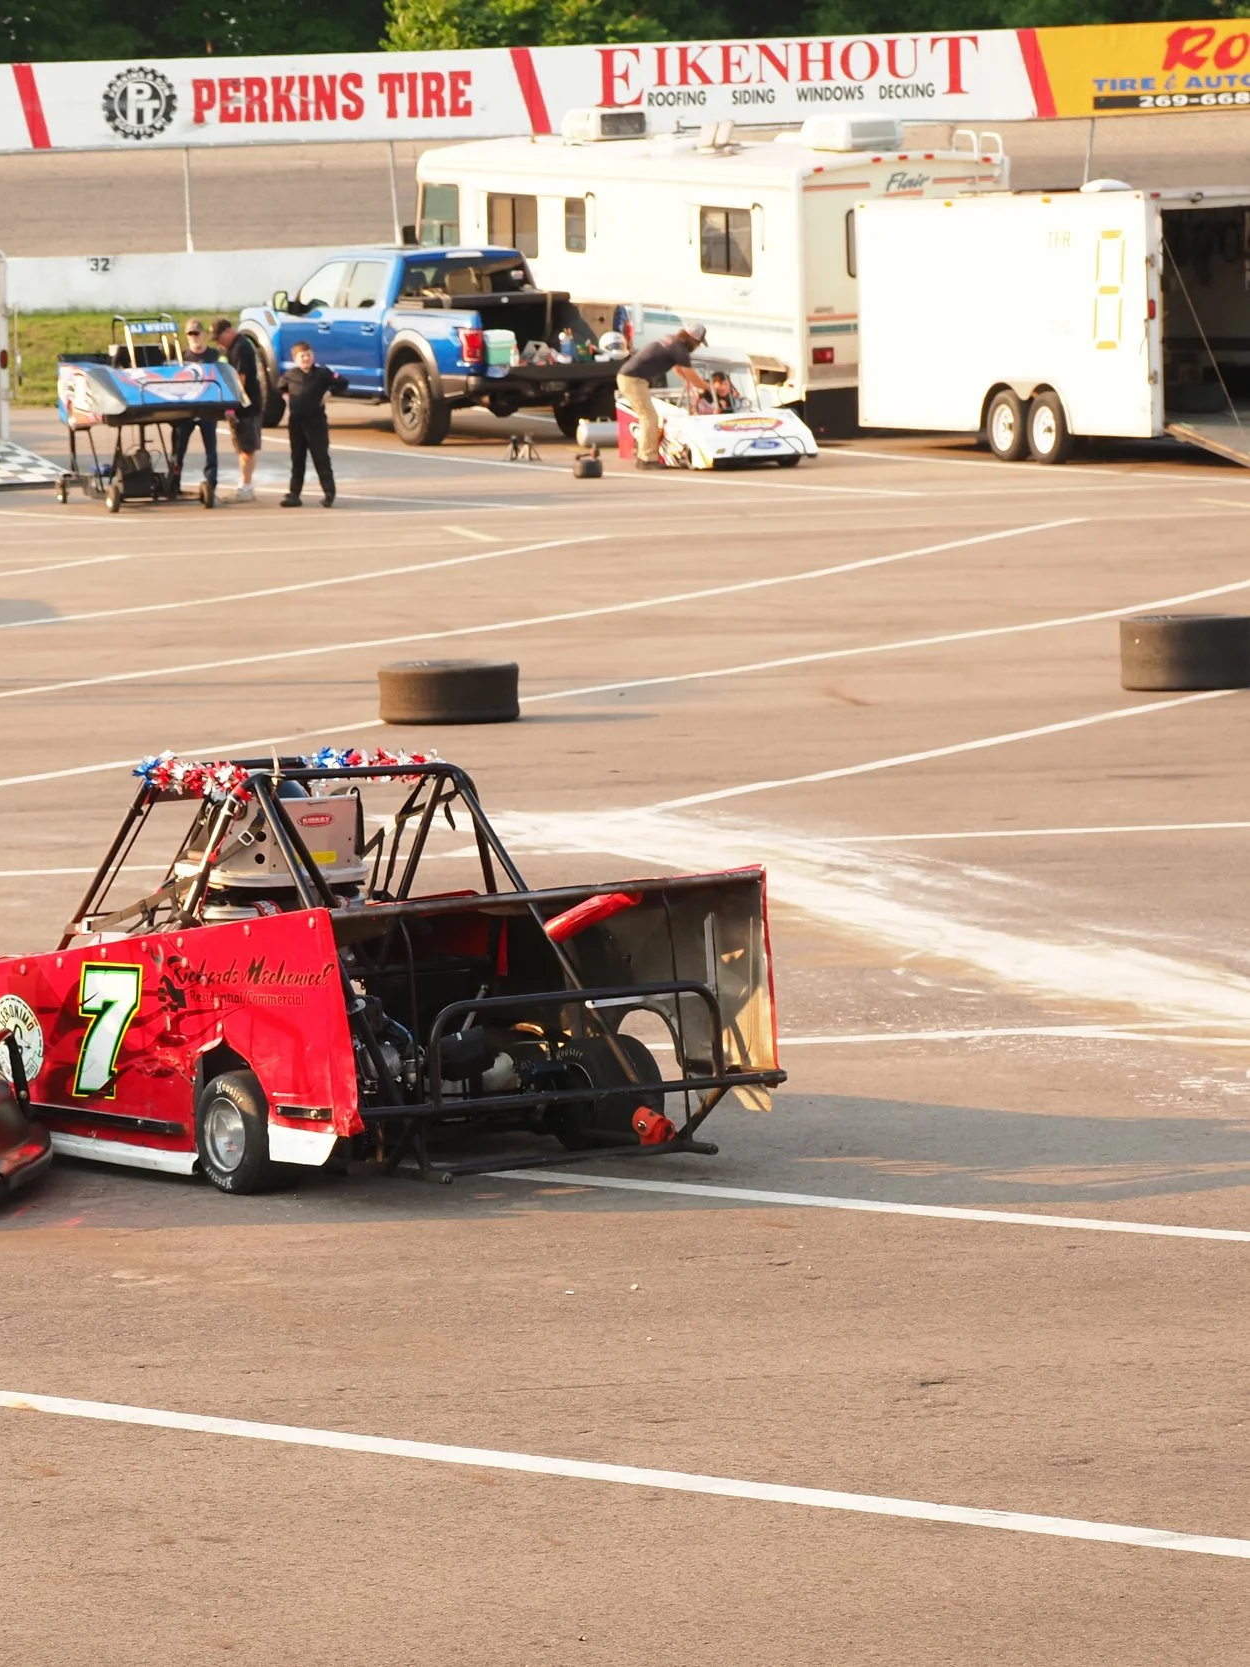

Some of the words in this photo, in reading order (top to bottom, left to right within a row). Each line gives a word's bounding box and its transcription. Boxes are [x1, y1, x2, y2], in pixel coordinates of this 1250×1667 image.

[595, 36, 978, 107] EIKENHOUT
[647, 92, 707, 107] ROOFING
[732, 89, 775, 105] SIDING
[796, 85, 864, 101] WINDOWS
[879, 83, 936, 100] DECKING
[1093, 77, 1156, 92] TIRE
[191, 73, 364, 124] PERKINS
[378, 70, 472, 119] TIRE
[1139, 91, 1250, 107] 269-668
[886, 171, 930, 192] Flair
[90, 257, 110, 271] 32
[241, 955, 335, 987] Mechanical
[189, 989, 304, 1006] Residntial/Commercial
[75, 963, 141, 1098] 7
